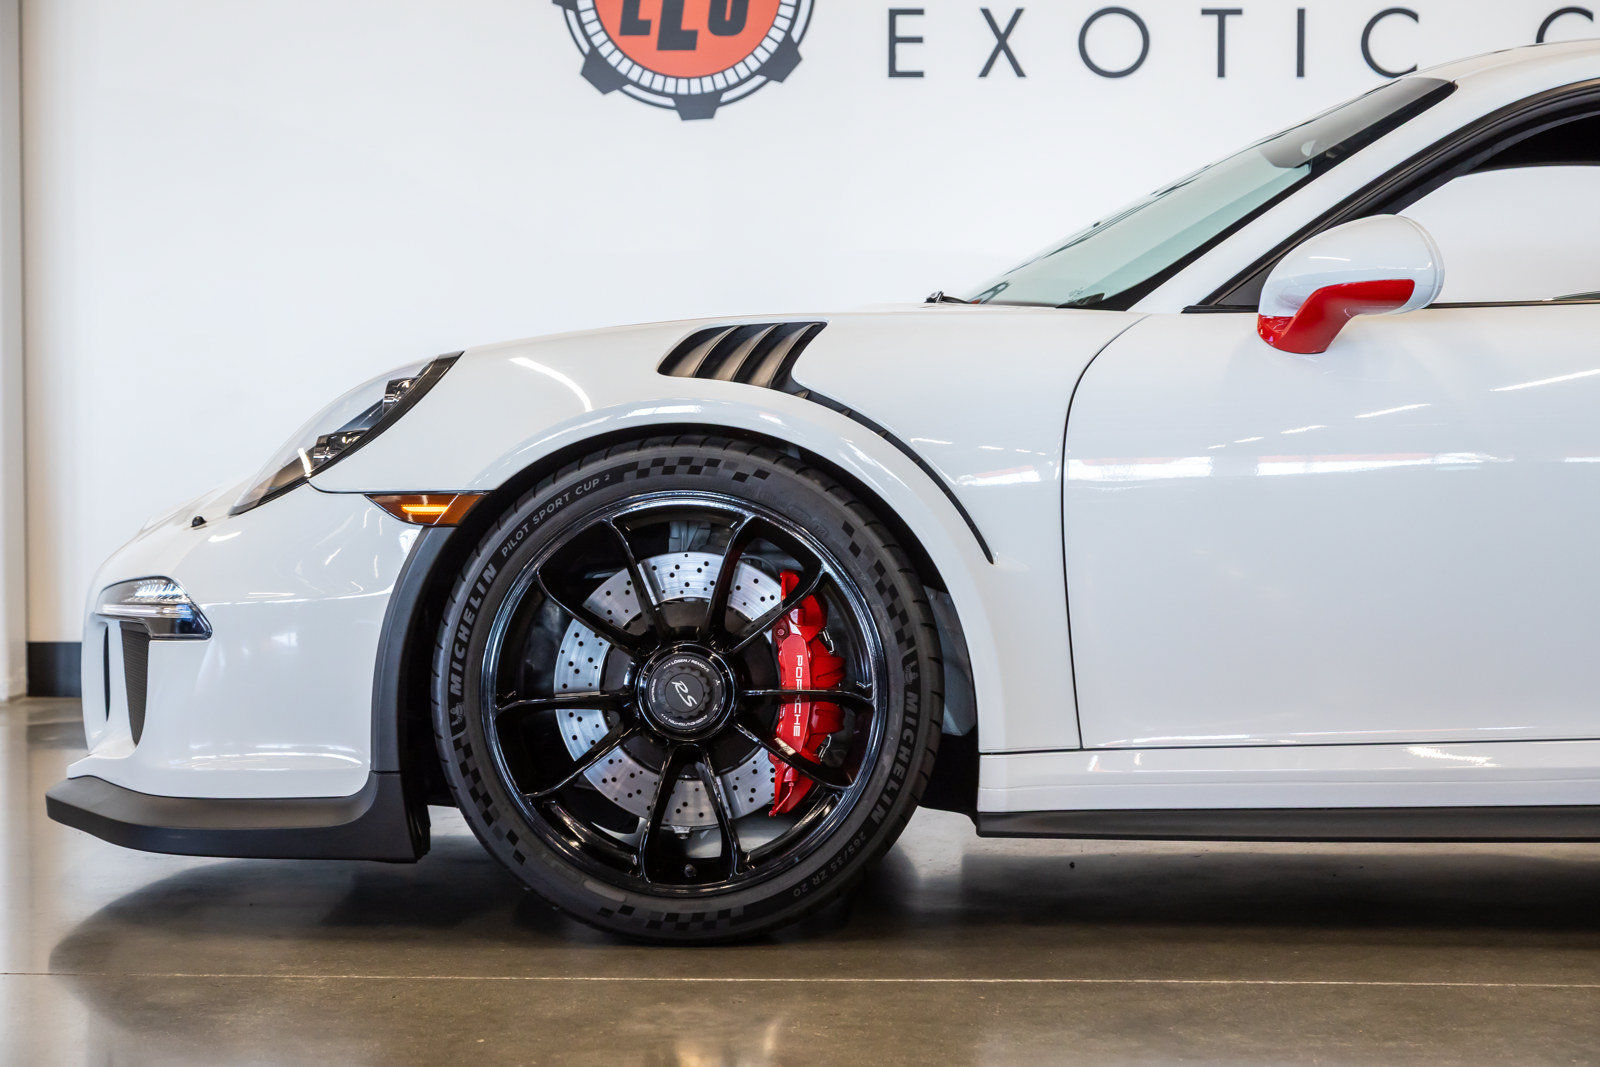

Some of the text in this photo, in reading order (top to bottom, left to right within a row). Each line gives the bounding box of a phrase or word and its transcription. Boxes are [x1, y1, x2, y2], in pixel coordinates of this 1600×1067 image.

[888, 7, 1419, 78] EXOTIC
[501, 523, 530, 557] PILOT
[532, 492, 571, 525] SPORT
[575, 478, 600, 495] CUP
[450, 563, 497, 697] MICHELIN
[793, 654, 804, 737] PORCHE
[870, 691, 919, 825] MICHELIN
[793, 882, 808, 897] 20
[812, 869, 828, 885] ZR
